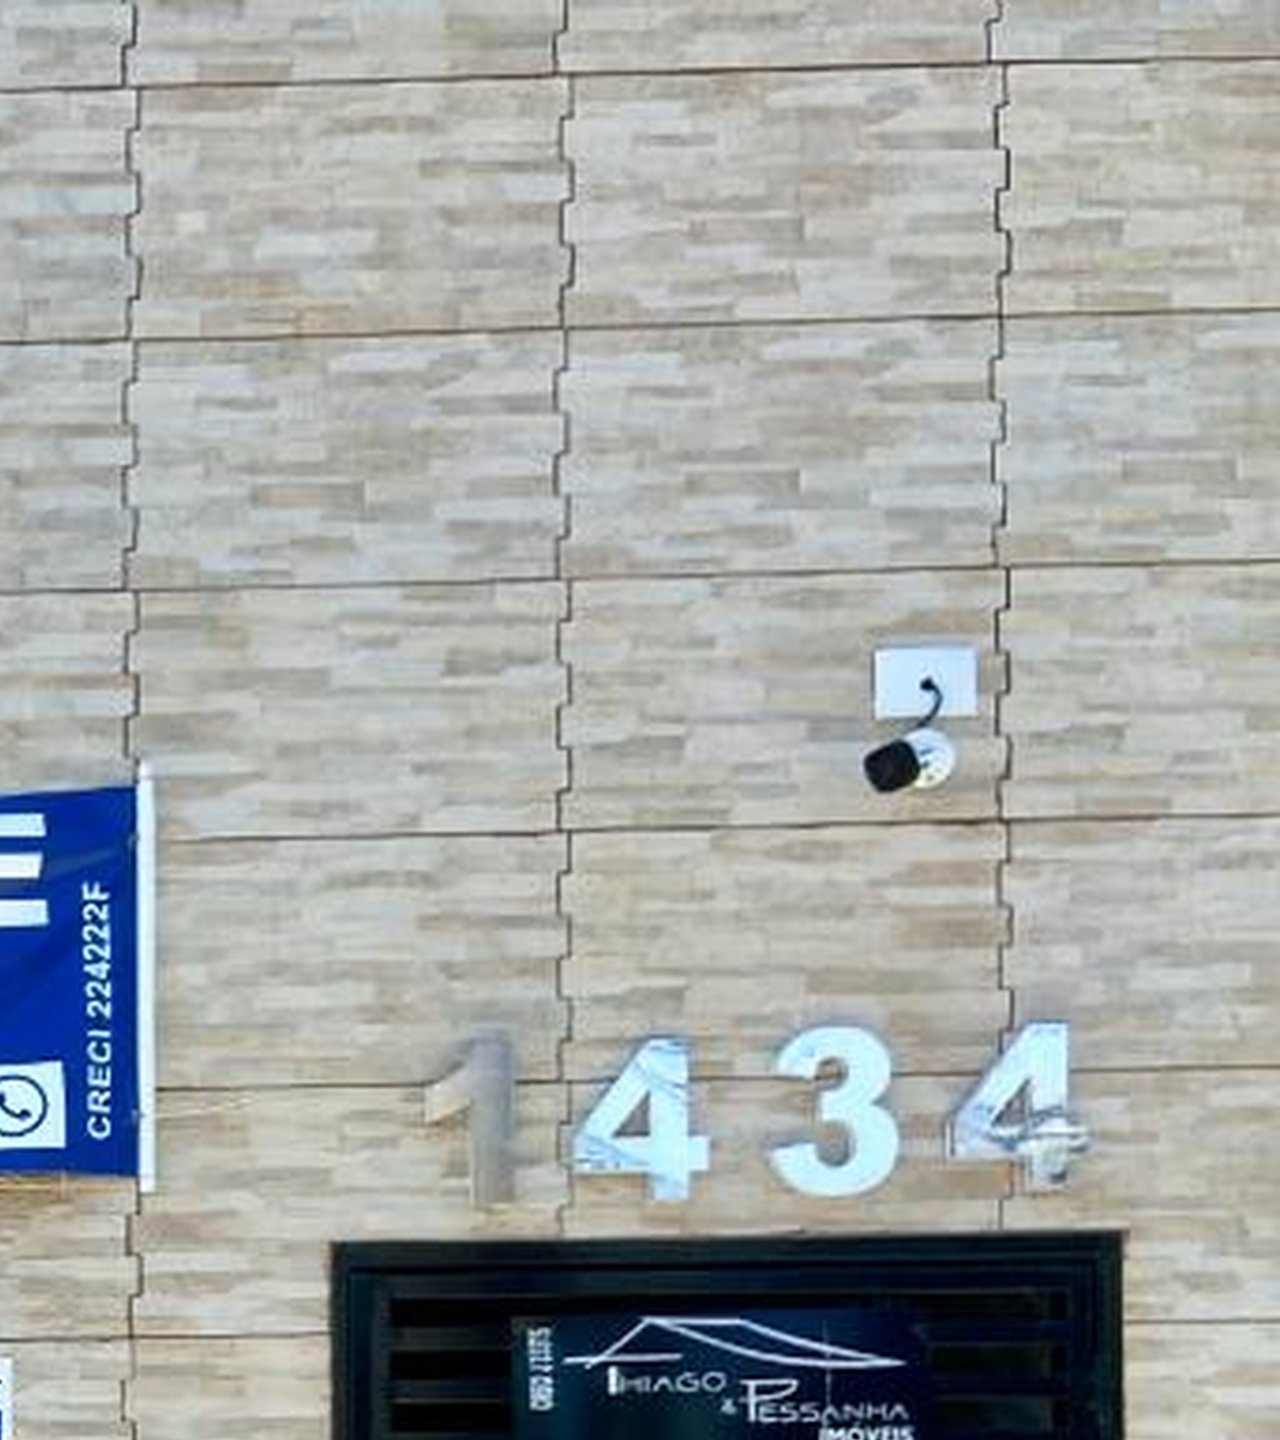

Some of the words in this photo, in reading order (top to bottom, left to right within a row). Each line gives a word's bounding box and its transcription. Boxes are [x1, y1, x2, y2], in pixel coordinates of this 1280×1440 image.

[83, 880, 112, 1020] 224222F
[85, 1030, 112, 1141] CRECI
[606, 1364, 726, 1396] THIAGO
[741, 1378, 910, 1424] PESSANHA
